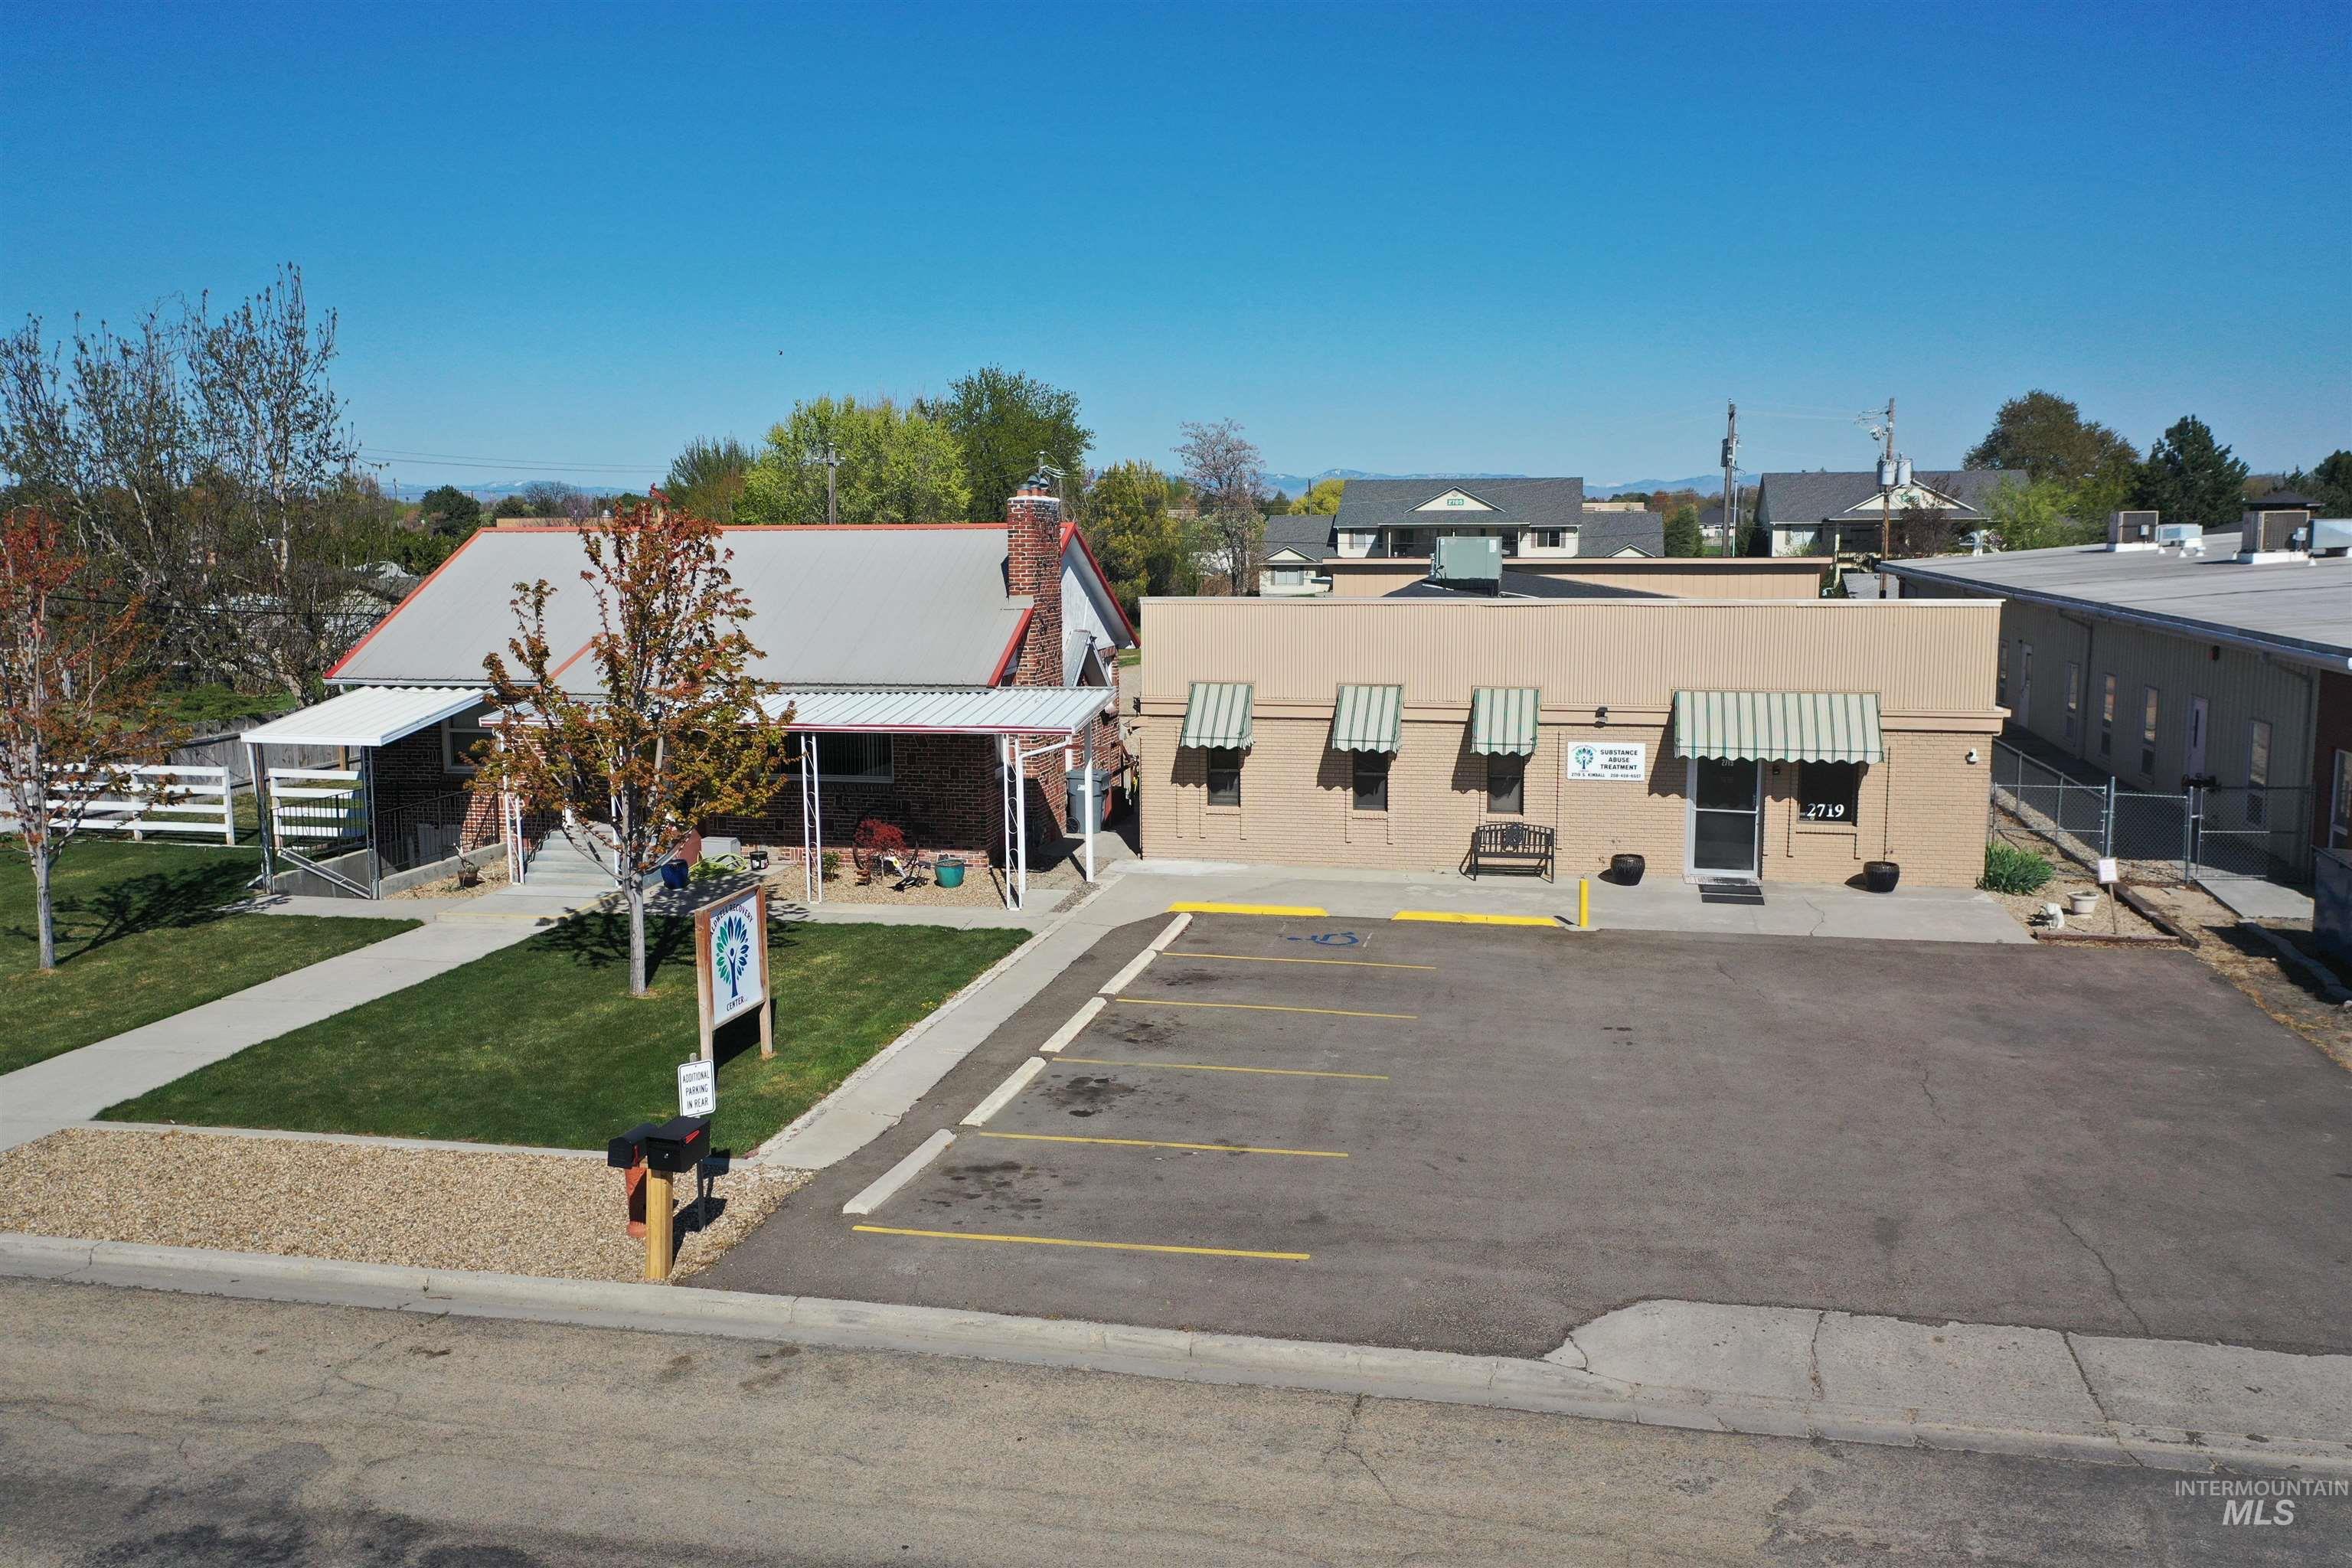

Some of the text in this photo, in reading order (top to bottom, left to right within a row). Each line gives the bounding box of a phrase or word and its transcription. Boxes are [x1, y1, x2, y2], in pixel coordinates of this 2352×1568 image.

[1807, 803, 1844, 818] 2719
[710, 903, 754, 940] ALDWELL RECOVERY
[727, 995, 744, 1011] CENTER
[682, 1070, 710, 1083] ADDITIONAL
[685, 1084, 708, 1096] PARKING
[687, 1096, 708, 1109] IN REAR
